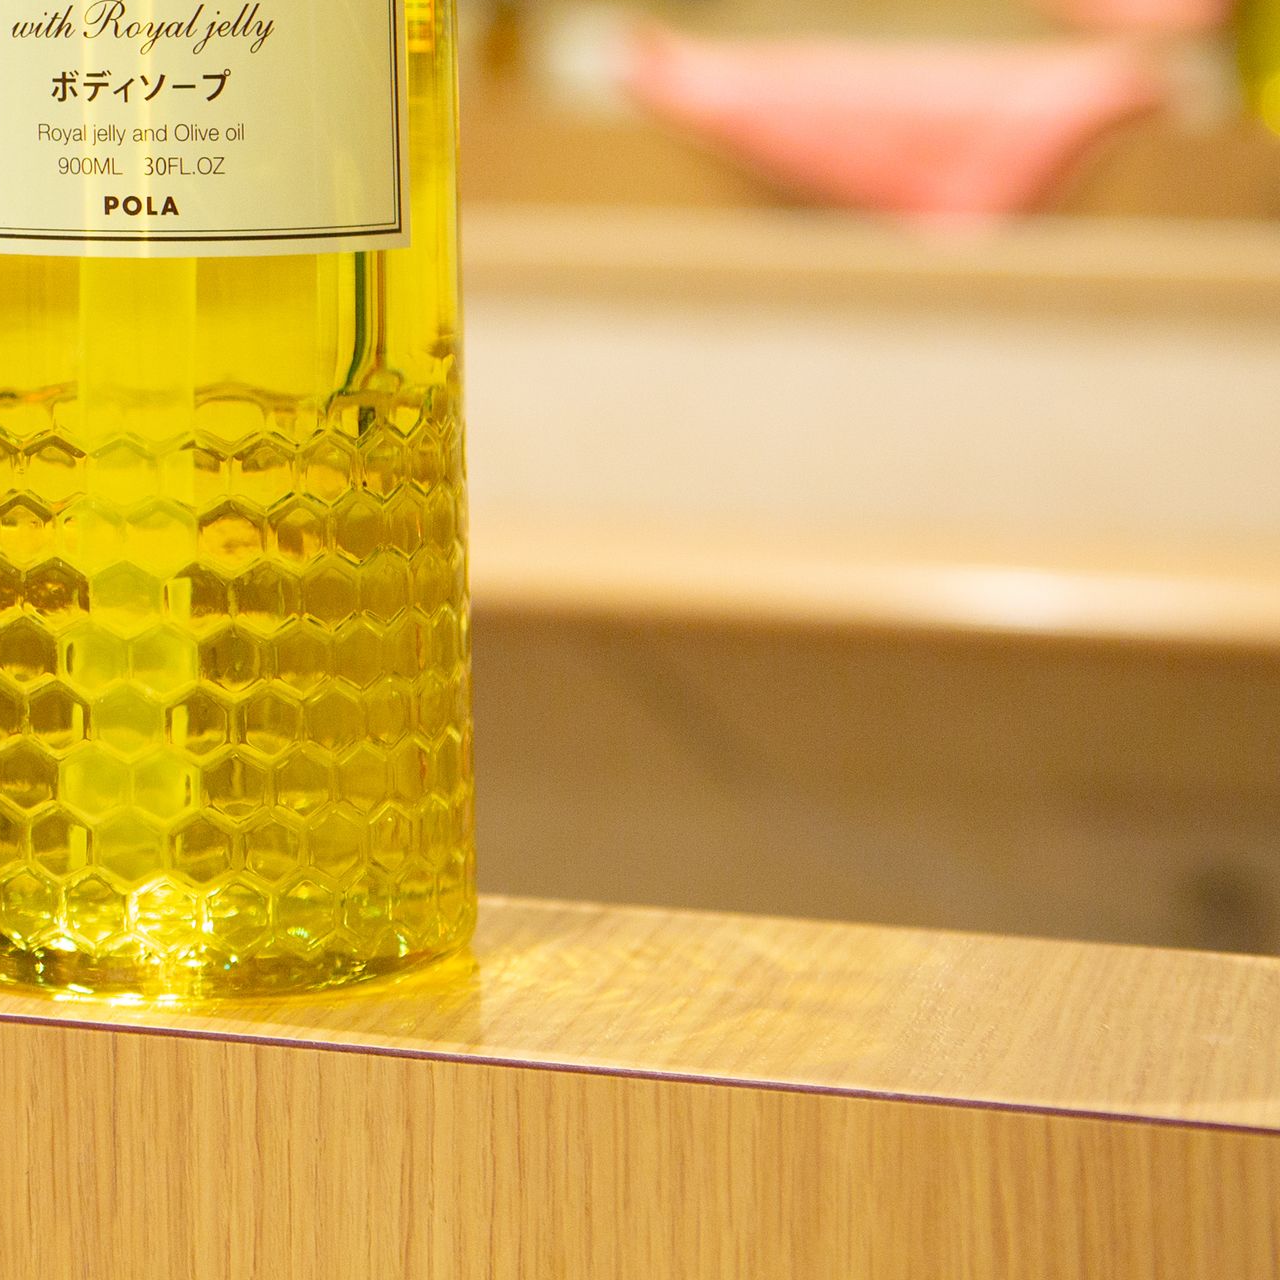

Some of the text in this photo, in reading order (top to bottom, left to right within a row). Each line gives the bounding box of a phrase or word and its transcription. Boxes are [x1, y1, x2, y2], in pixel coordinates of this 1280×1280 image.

[11, 0, 274, 55] with Royal jelly
[51, 68, 231, 103] ボディソープ
[38, 123, 245, 146] Royal jelly and Olive oil
[58, 156, 226, 176] 900ML 30FL.OZ
[104, 195, 180, 216] POLA
